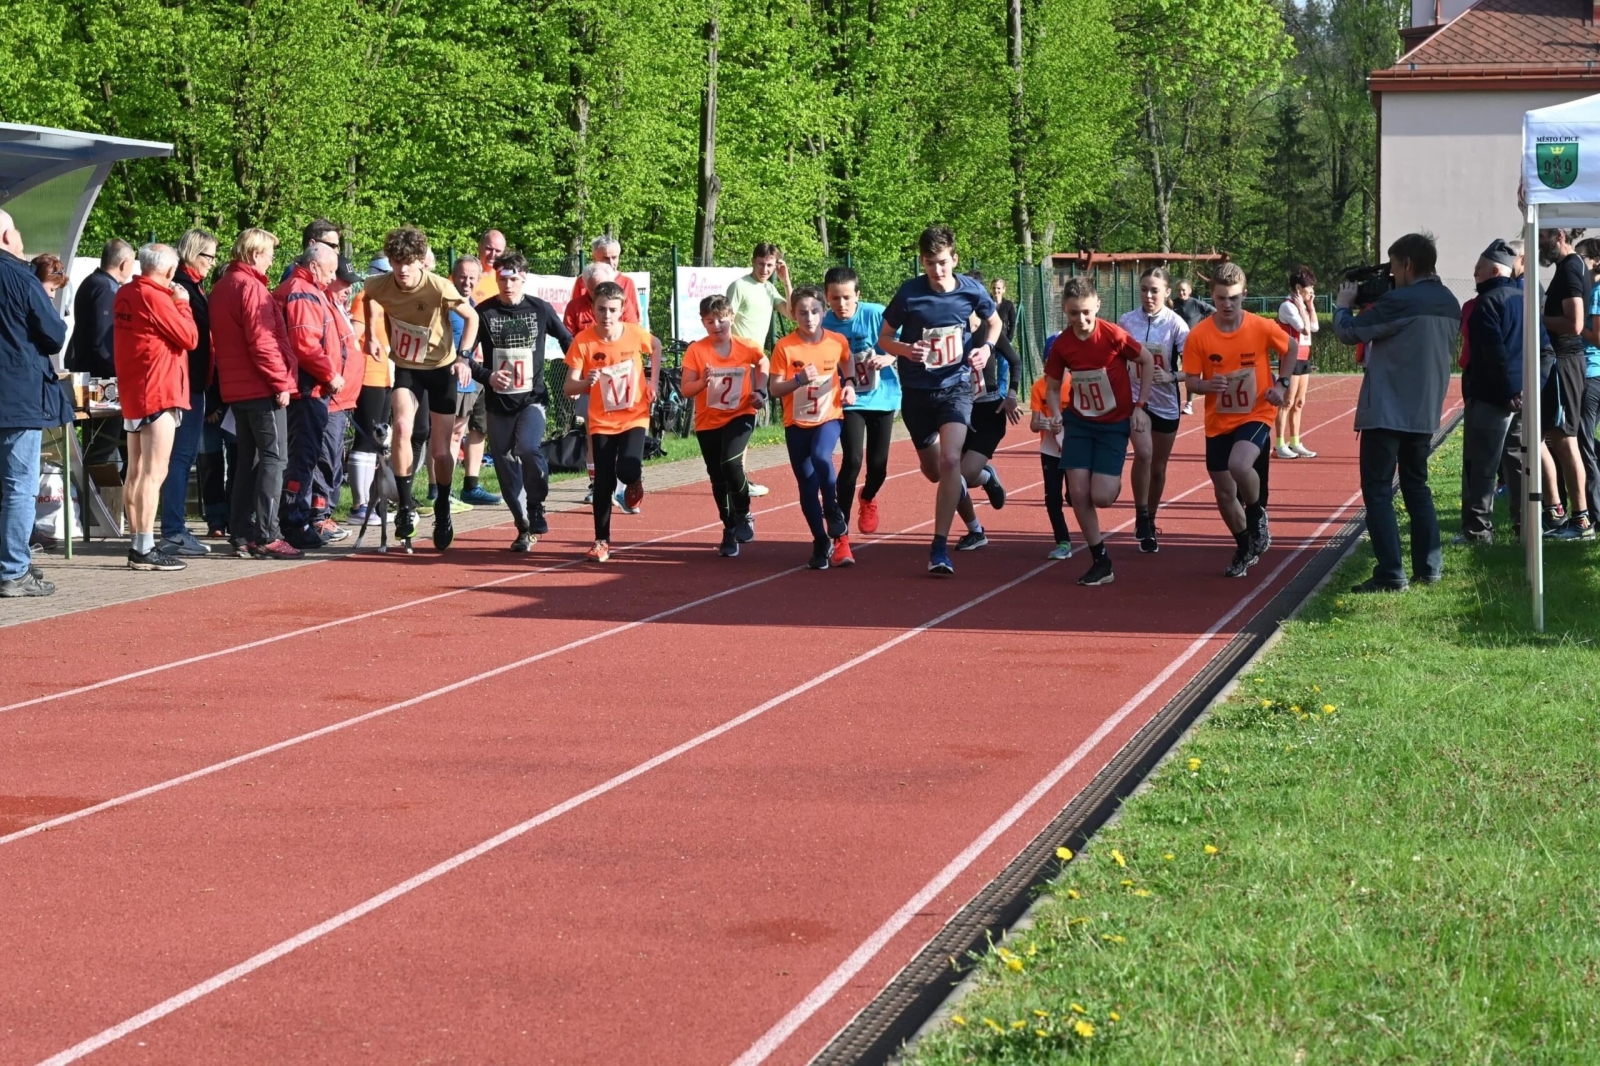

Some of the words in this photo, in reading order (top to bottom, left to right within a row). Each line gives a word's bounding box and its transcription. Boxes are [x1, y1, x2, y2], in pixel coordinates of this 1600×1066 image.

[394, 329, 421, 362] 181
[930, 335, 956, 366] 50
[720, 376, 733, 405] 2
[807, 386, 819, 415] 5
[1078, 382, 1105, 411] 68
[1221, 379, 1249, 408] 66
